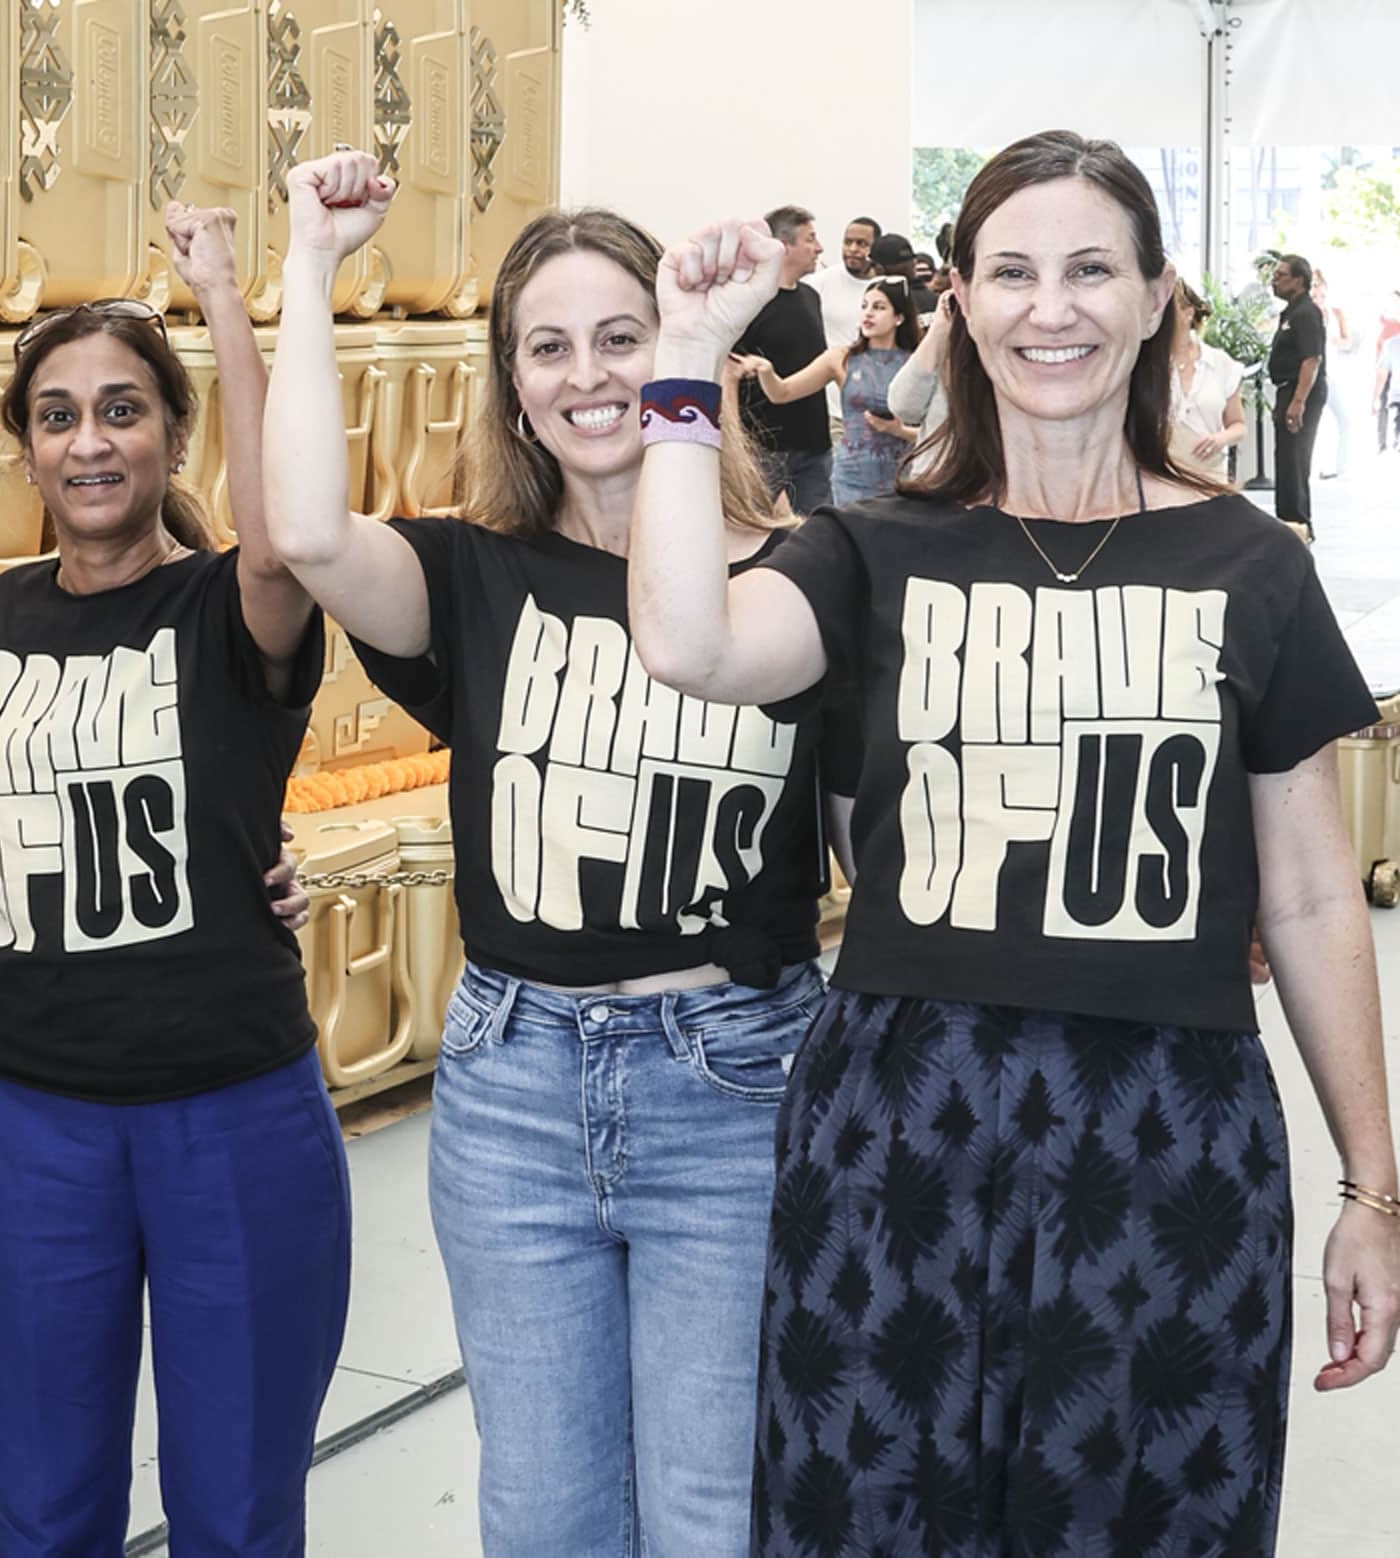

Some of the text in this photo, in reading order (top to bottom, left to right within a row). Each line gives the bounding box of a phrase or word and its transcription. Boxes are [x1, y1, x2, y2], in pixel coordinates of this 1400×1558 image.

[898, 576, 1229, 743] BRAVE
[67, 774, 180, 939] US
[491, 754, 637, 931] OF
[899, 733, 1207, 931] OF US
